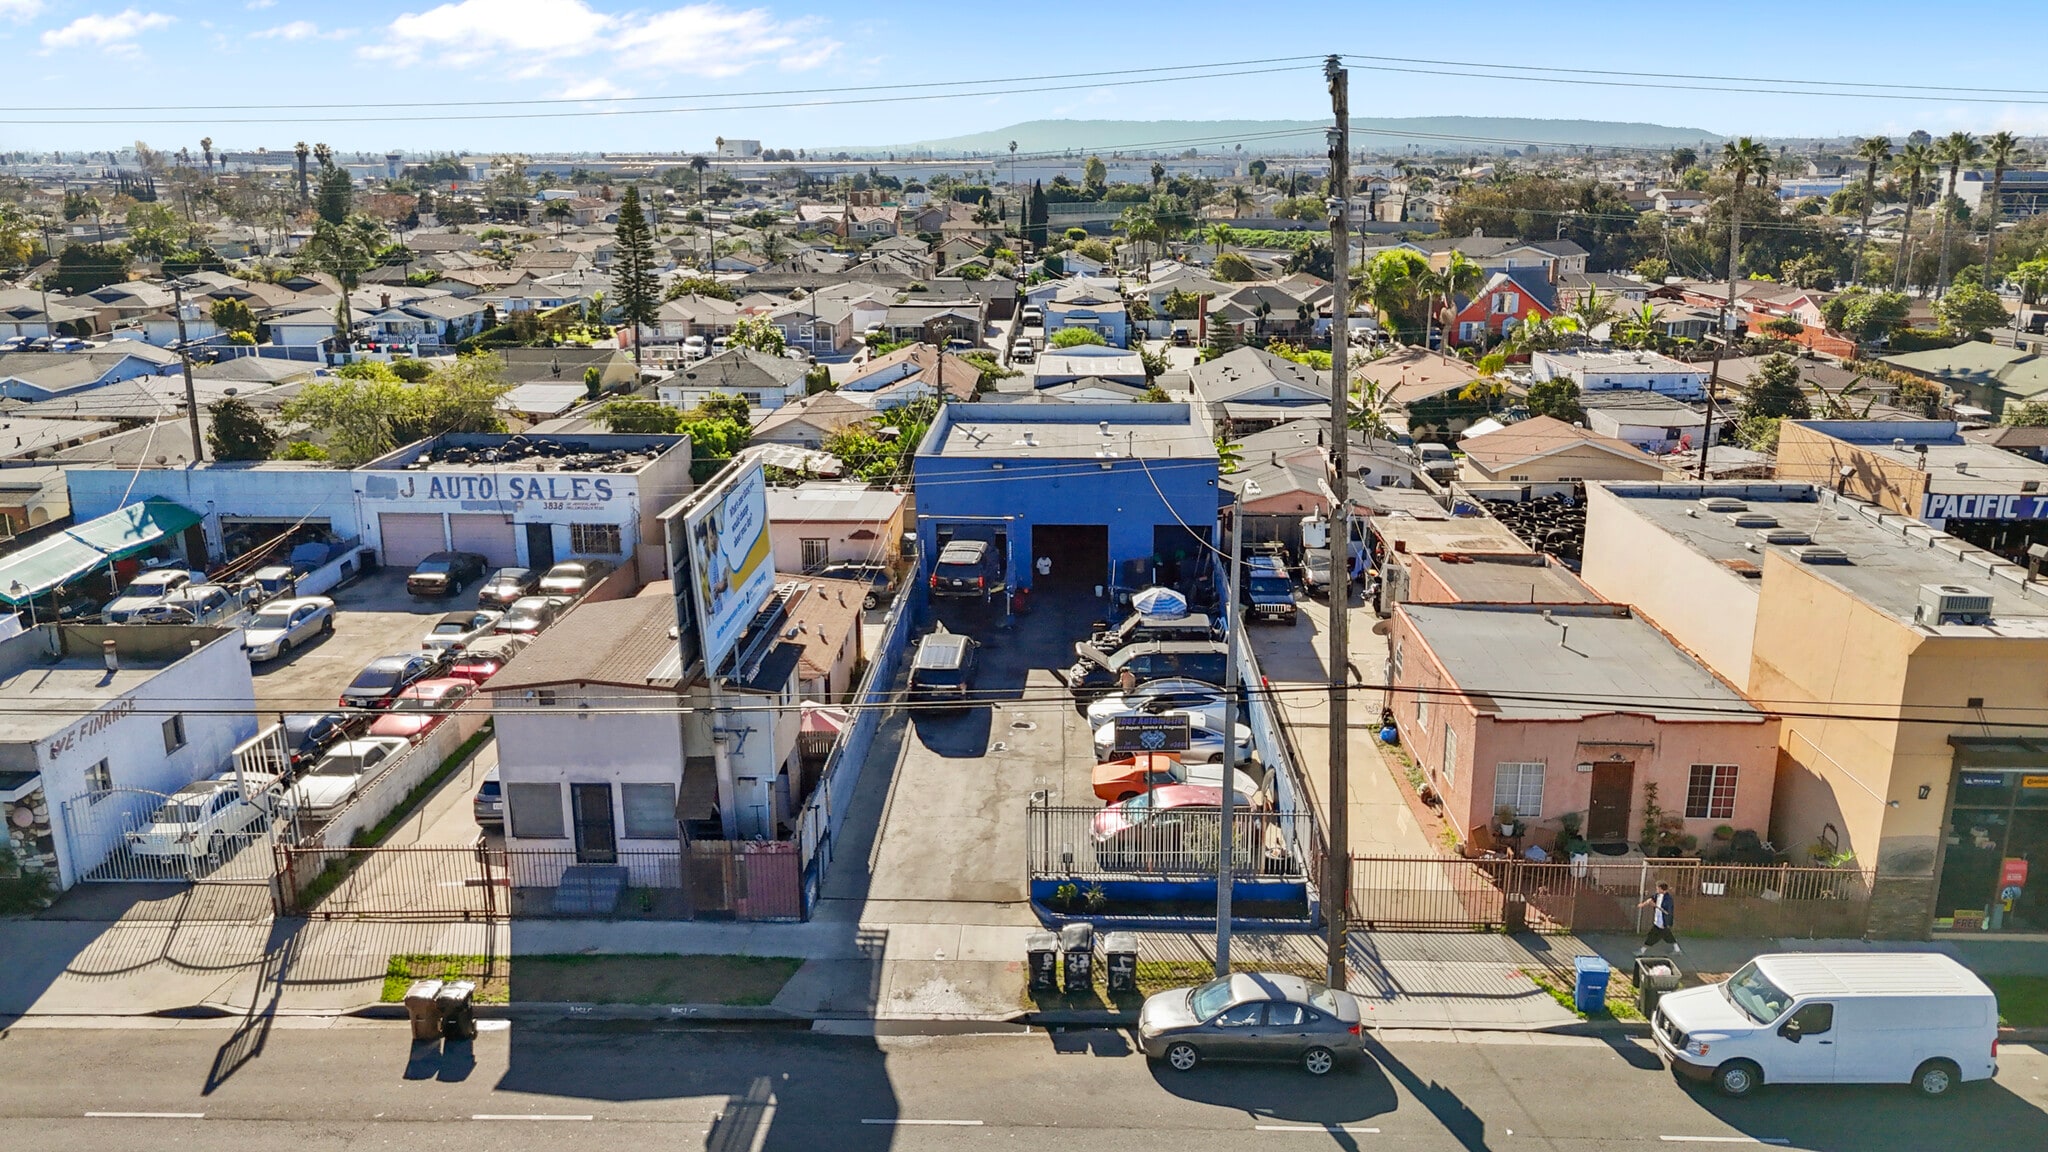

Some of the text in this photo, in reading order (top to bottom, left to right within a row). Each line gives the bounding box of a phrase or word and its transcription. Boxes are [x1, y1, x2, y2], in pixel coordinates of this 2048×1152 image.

[400, 476, 613, 501] J AUTO SALES
[543, 501, 564, 511] 3838
[1927, 494, 2048, 518] PACIFIC T
[49, 696, 137, 760] WE FINANCE
